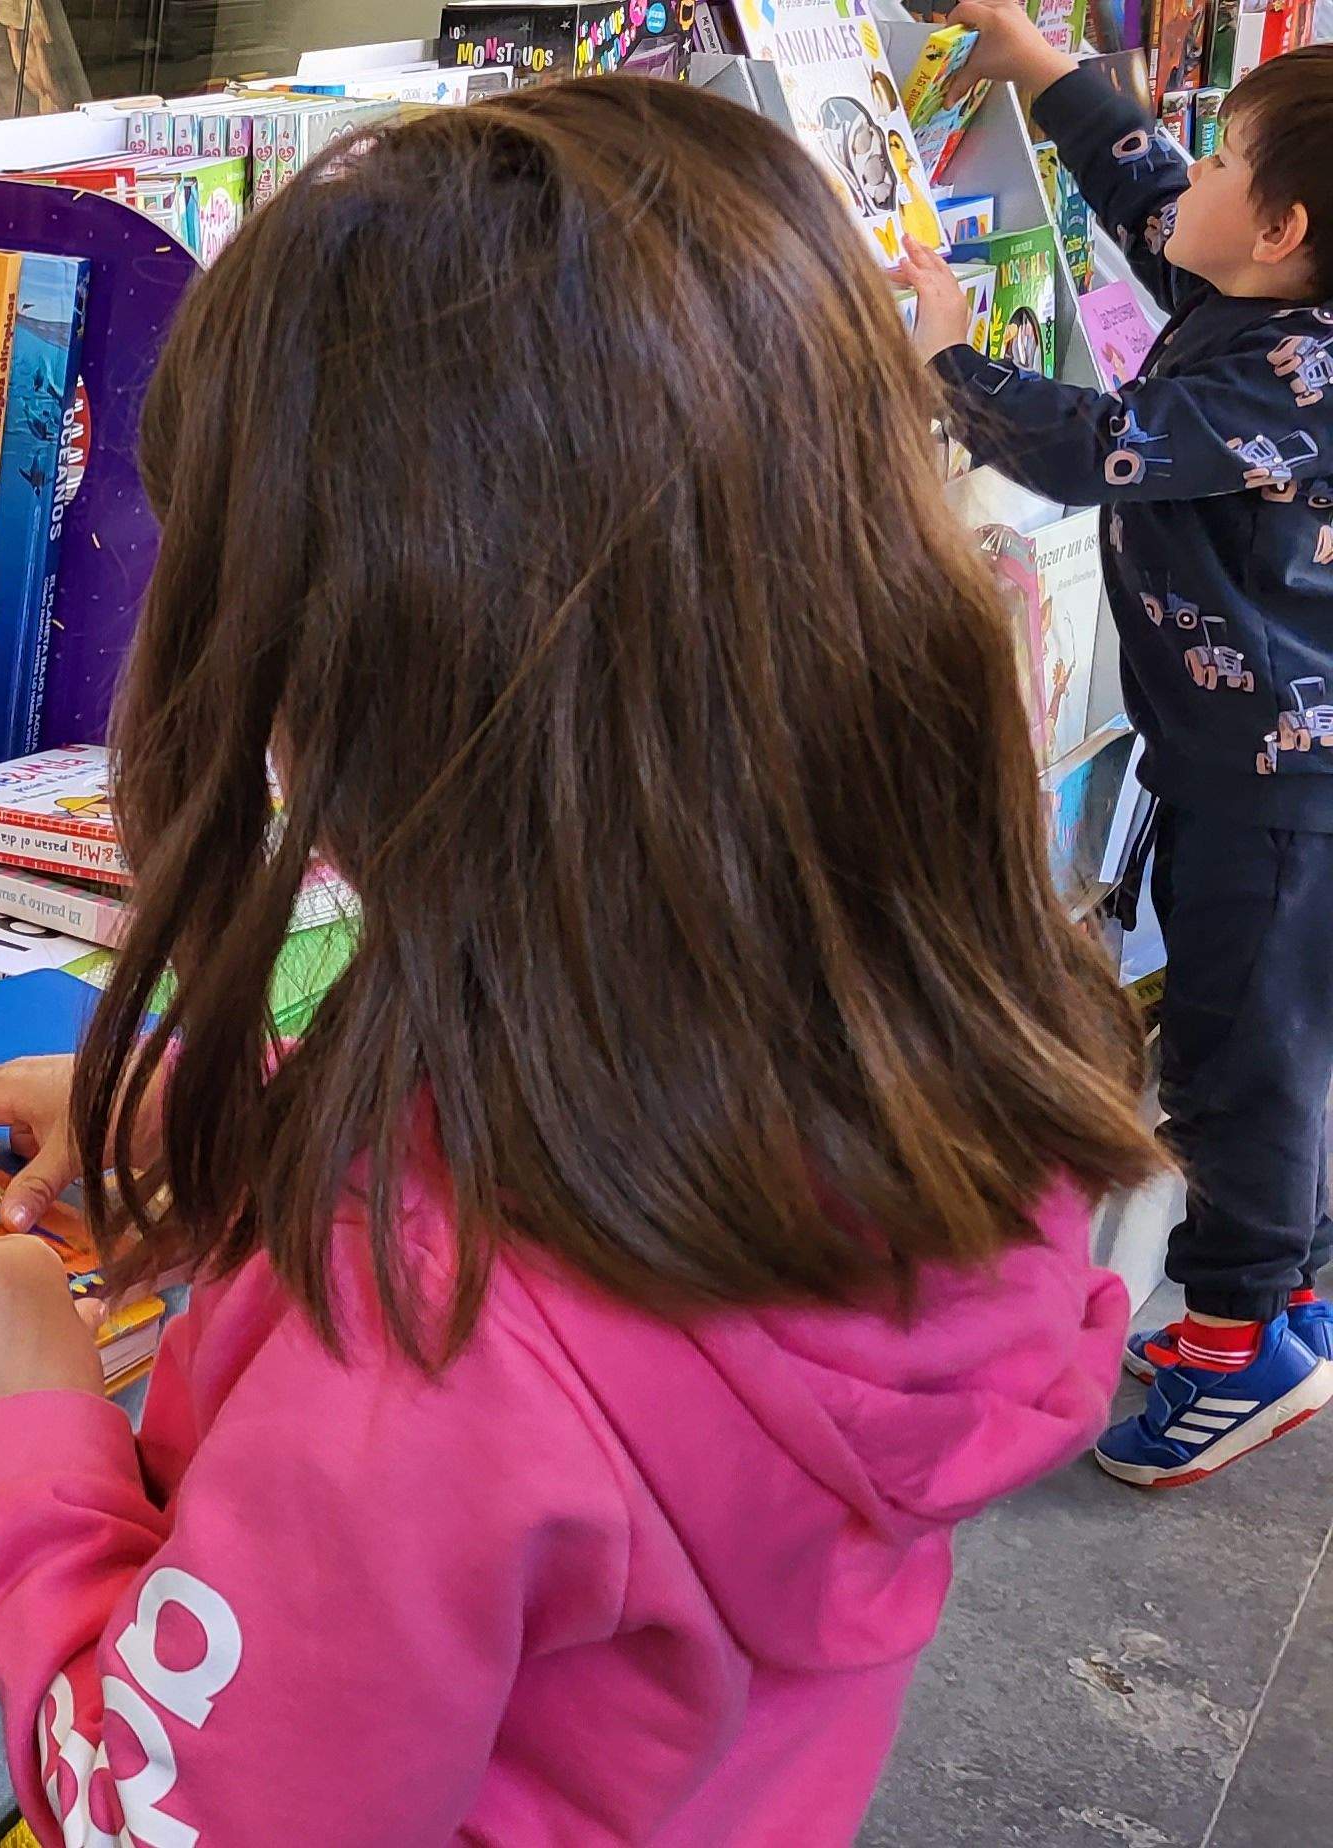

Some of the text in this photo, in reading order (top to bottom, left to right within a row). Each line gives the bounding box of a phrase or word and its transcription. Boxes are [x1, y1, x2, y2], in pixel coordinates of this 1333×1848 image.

[450, 24, 465, 40] LOS
[457, 37, 554, 72] MONSTRUOS
[774, 24, 864, 68] ANIMALES
[49, 406, 75, 542] OCEANOS
[1065, 540, 1082, 560] un
[0, 833, 17, 847] día
[34, 837, 68, 853] pasan
